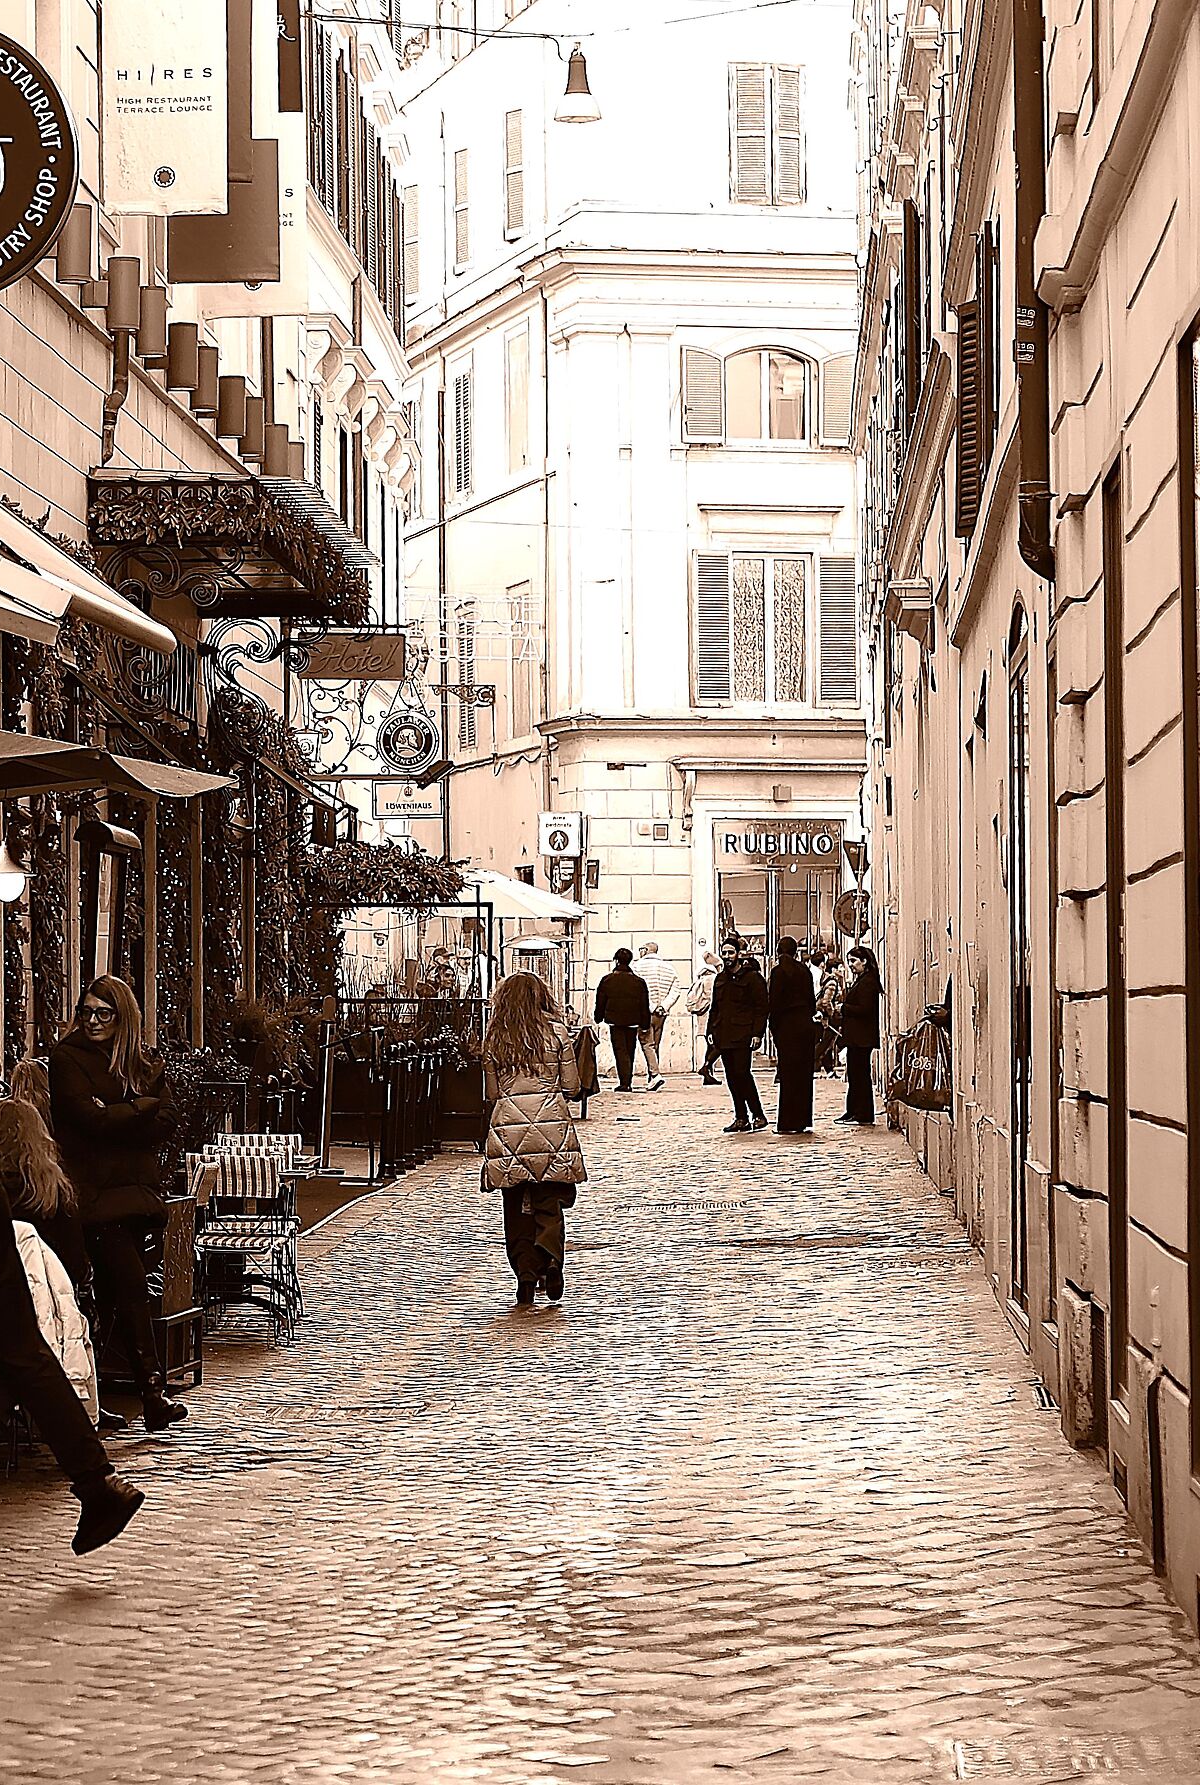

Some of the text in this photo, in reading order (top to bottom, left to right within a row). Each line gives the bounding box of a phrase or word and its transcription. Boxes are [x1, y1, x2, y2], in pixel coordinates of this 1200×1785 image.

[24, 167, 58, 227] SHOP
[306, 640, 400, 674] Hotel
[386, 716, 430, 735] PAULANER
[724, 832, 834, 856] RUBINO
